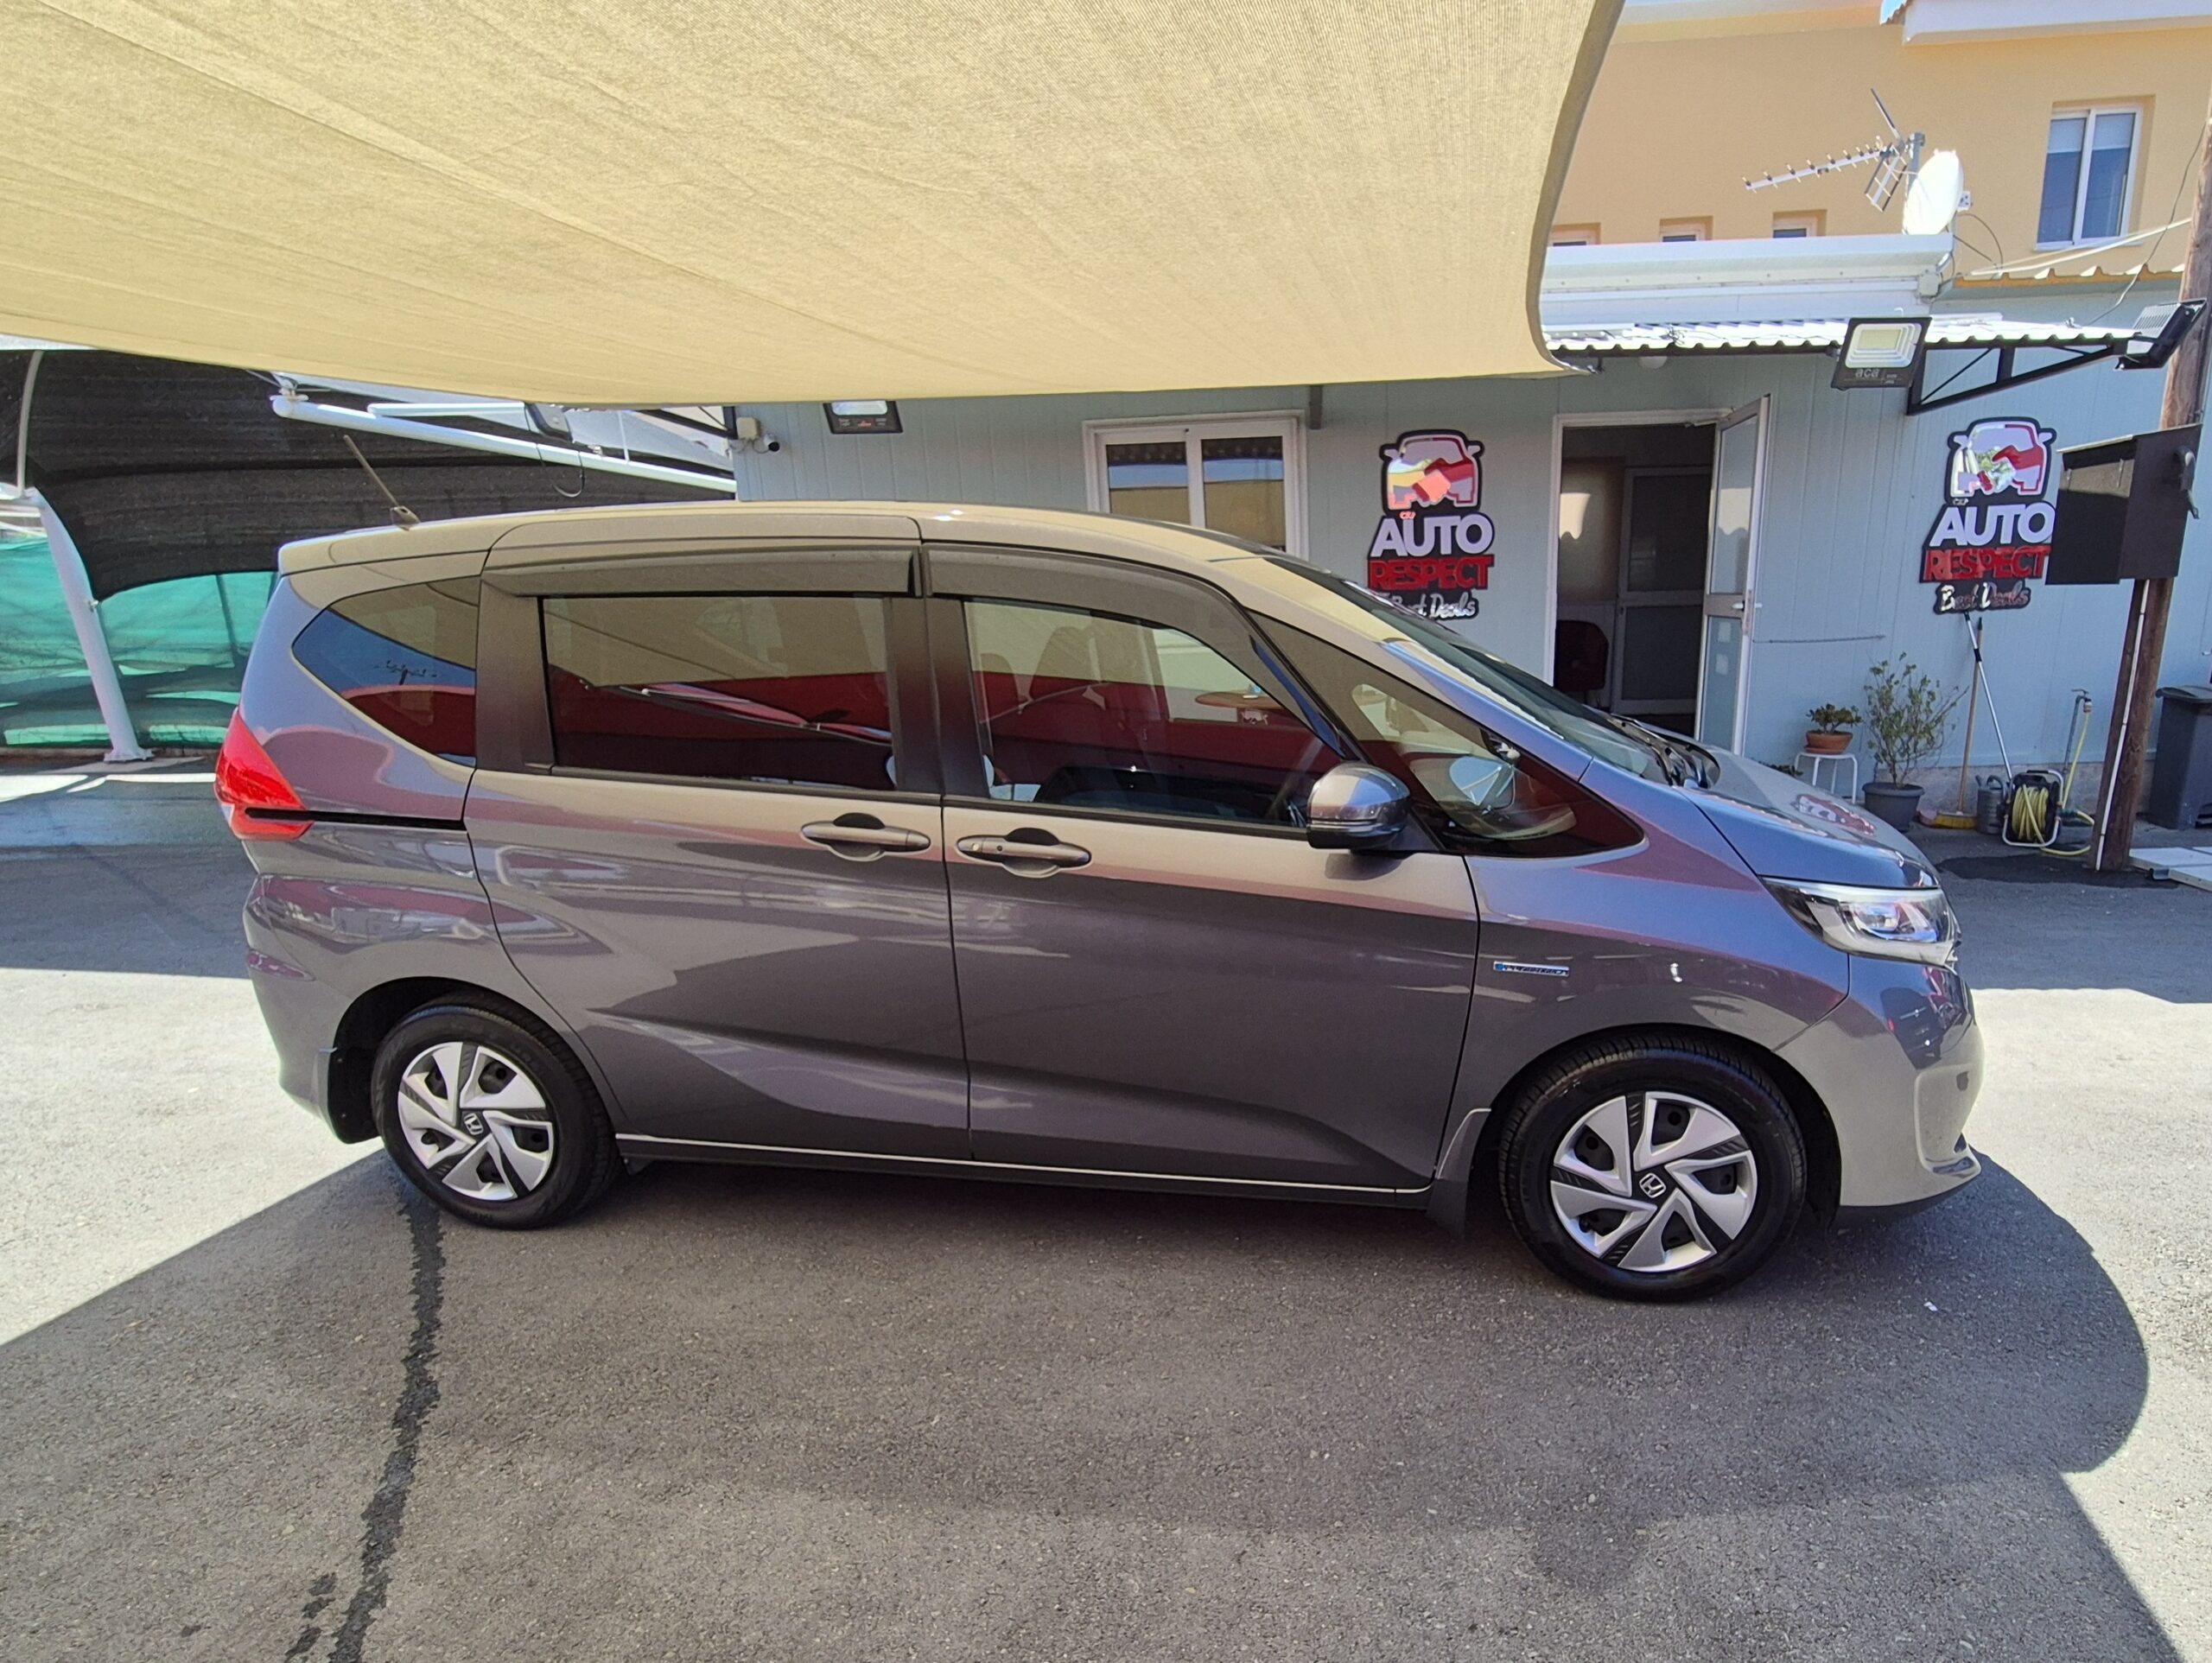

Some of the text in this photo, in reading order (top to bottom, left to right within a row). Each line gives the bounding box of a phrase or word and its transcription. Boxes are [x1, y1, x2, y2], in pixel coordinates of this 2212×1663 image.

[1370, 513, 1493, 557] AUTO
[1929, 503, 2056, 547] AUTO
[1369, 555, 1495, 591] RESPECT
[1923, 546, 2051, 581] RESPECT
[1429, 591, 1477, 619] Deals
